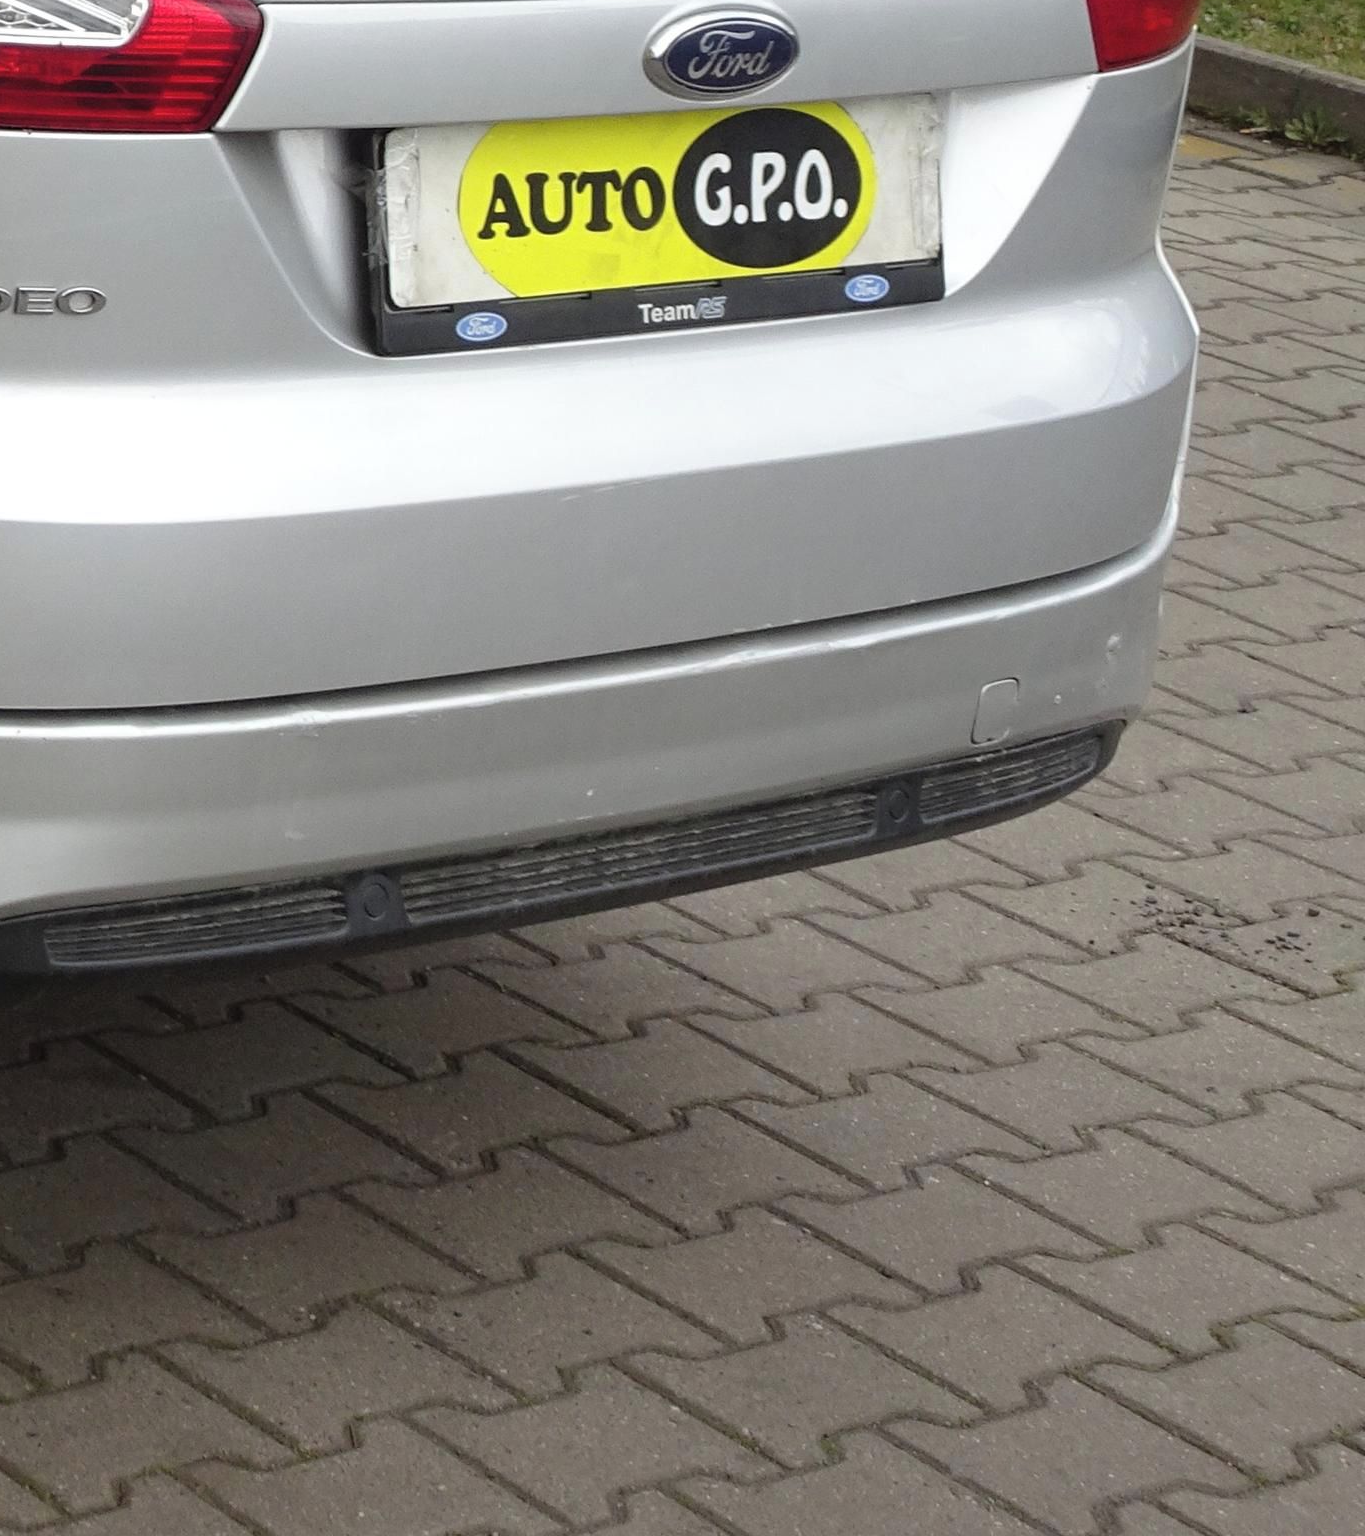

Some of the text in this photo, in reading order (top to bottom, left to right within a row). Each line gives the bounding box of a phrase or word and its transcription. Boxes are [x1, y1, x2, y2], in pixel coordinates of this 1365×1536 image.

[688, 30, 774, 79] Ford
[477, 149, 849, 240] AUTO G.P.O.
